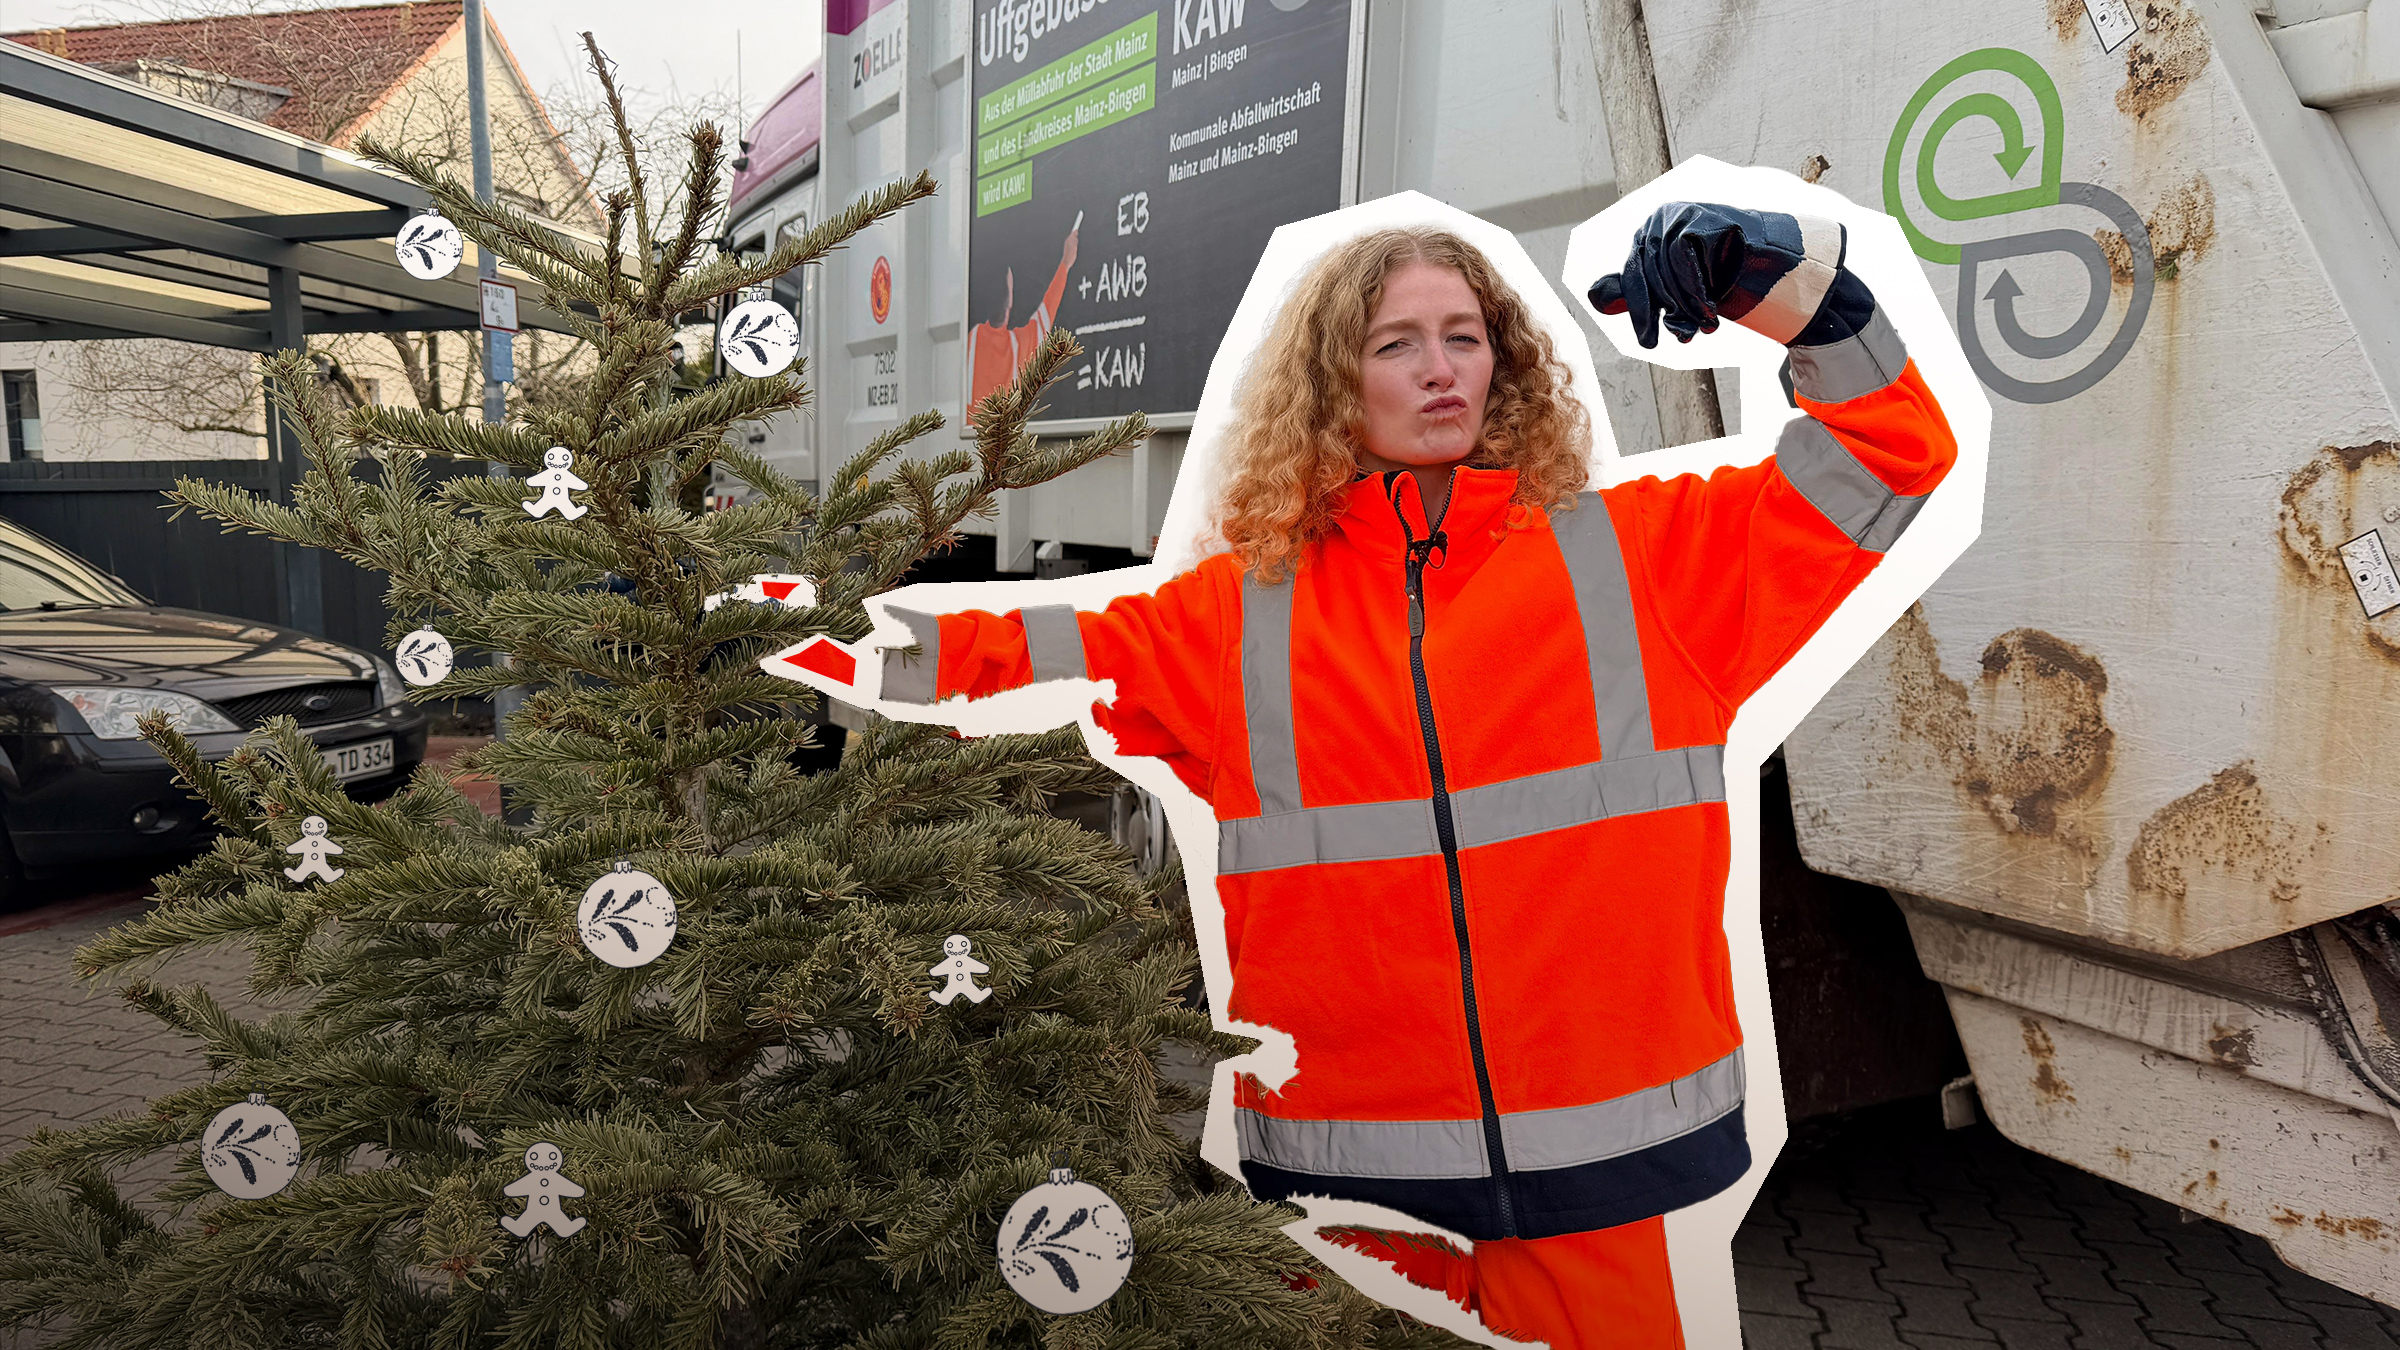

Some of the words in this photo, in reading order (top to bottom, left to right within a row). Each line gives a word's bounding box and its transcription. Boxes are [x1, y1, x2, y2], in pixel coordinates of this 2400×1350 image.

[980, 0, 1108, 67] Uffgeba
[1173, 0, 1245, 55] KAW
[984, 103, 1000, 124] Aus
[1001, 94, 1016, 115] der
[1016, 69, 1065, 109] Müllabfuhr
[1066, 62, 1084, 85] der
[1085, 45, 1113, 77] Stadt
[1114, 31, 1148, 63] Mainz
[1172, 63, 1203, 88] Mainz
[1210, 44, 1247, 73] Bingen
[984, 145, 1000, 164] und
[1001, 136, 1016, 158] des
[1017, 114, 1072, 150] Landkreises
[1074, 82, 1147, 128] Mainz-Bingen
[1169, 116, 1228, 153] Kommunale
[1229, 81, 1321, 132] Abfallwirtschaft
[1168, 160, 1198, 184] Mainz
[1199, 149, 1219, 174] und
[1221, 128, 1298, 168] Mainz-Bingen
[982, 180, 1000, 206] wird
[1002, 172, 1026, 200] KAW!
[1117, 191, 1149, 236] EB
[337, 749, 358, 775] TD
[363, 742, 391, 768] 334
